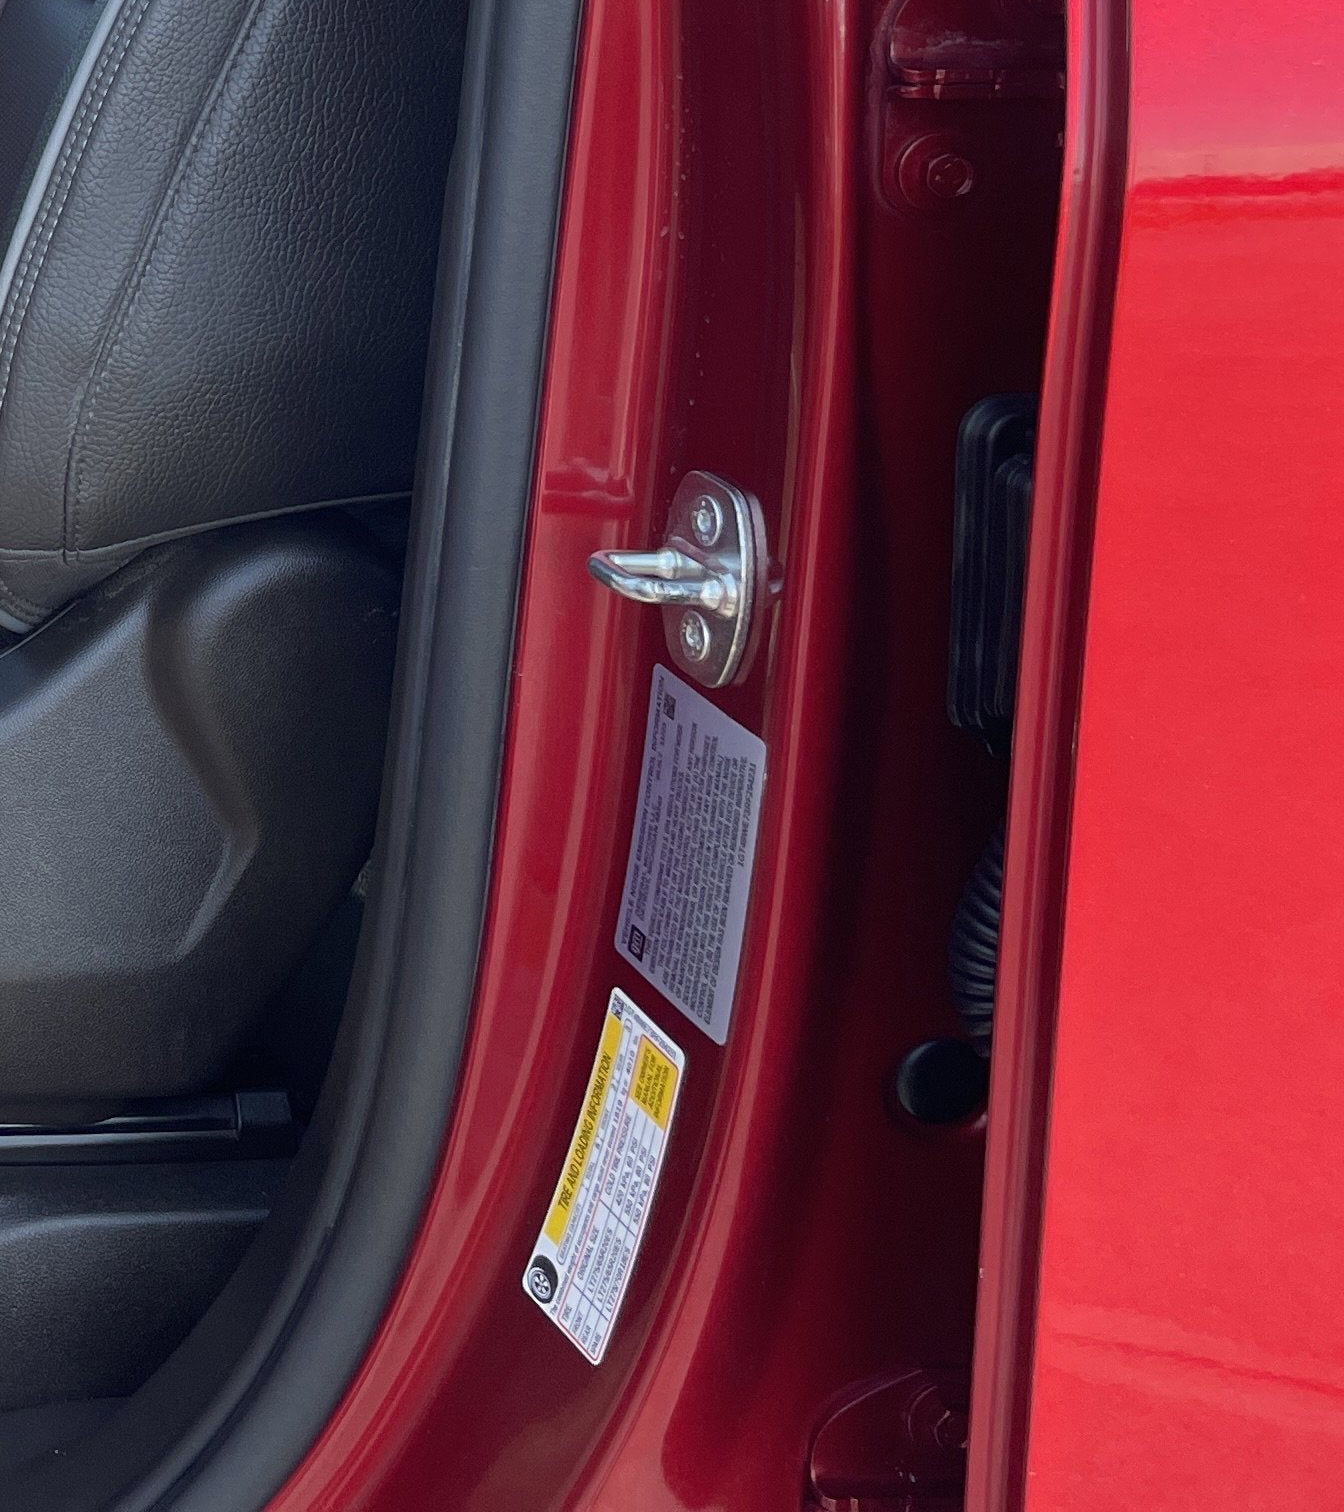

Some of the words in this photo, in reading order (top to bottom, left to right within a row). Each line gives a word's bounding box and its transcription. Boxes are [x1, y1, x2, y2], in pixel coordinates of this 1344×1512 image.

[585, 1049, 612, 1123] INFORMATION
[572, 1116, 594, 1168] LOADING
[565, 1160, 580, 1189] AND
[557, 1183, 573, 1213] TIRE
